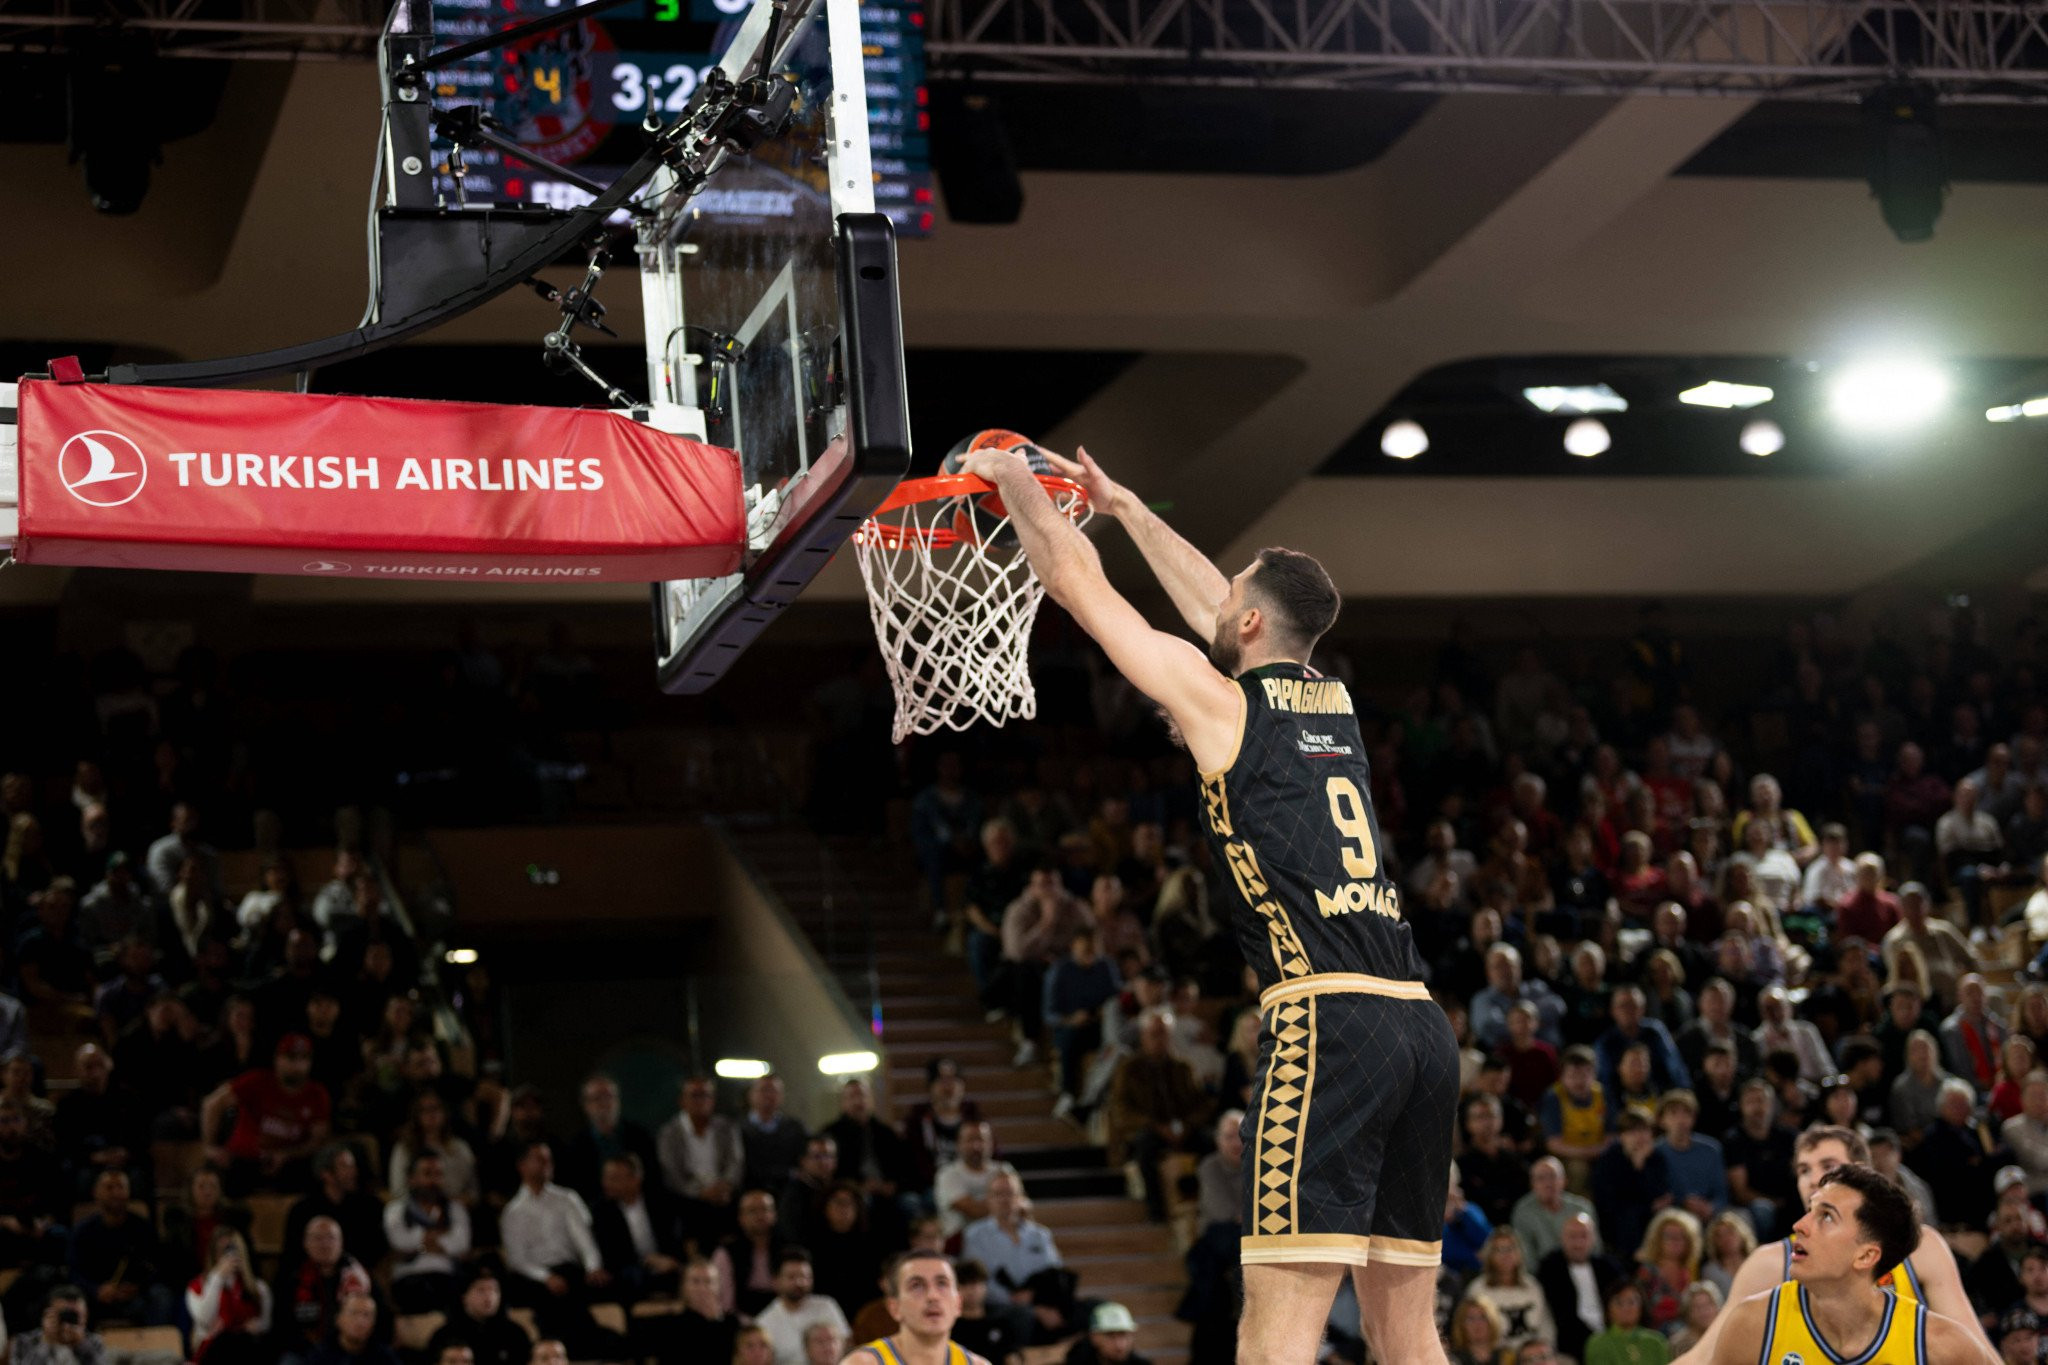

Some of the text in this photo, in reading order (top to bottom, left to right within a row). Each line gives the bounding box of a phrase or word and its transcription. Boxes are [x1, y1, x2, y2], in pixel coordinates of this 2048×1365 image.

[533, 66, 561, 105] 4
[611, 63, 710, 112] 3:2
[168, 453, 604, 491] TURKISH AIRLINES
[364, 565, 602, 577] TURKISH AIRLINES
[1326, 776, 1377, 879] 9
